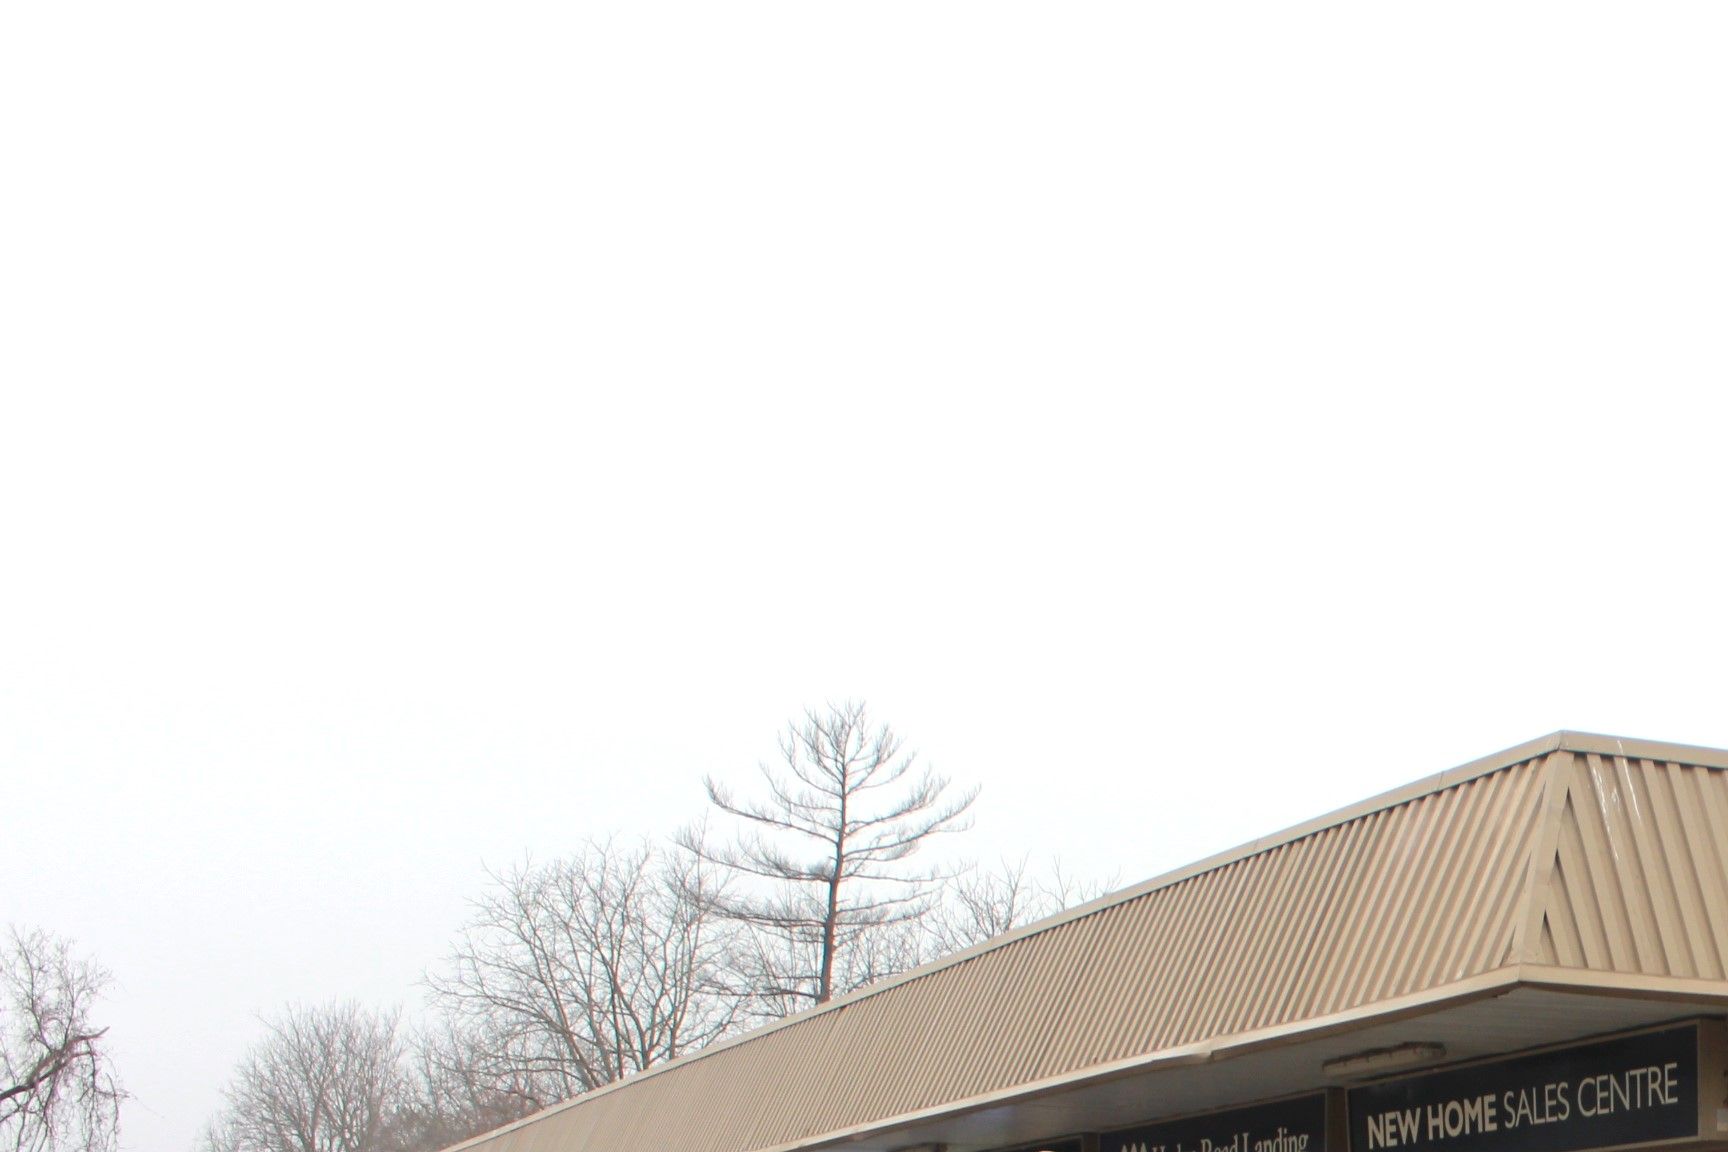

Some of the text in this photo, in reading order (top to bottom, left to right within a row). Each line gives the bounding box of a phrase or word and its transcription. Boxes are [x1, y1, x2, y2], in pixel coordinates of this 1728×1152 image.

[1367, 1062, 1679, 1150] NEW HOME SALES CENTRE
